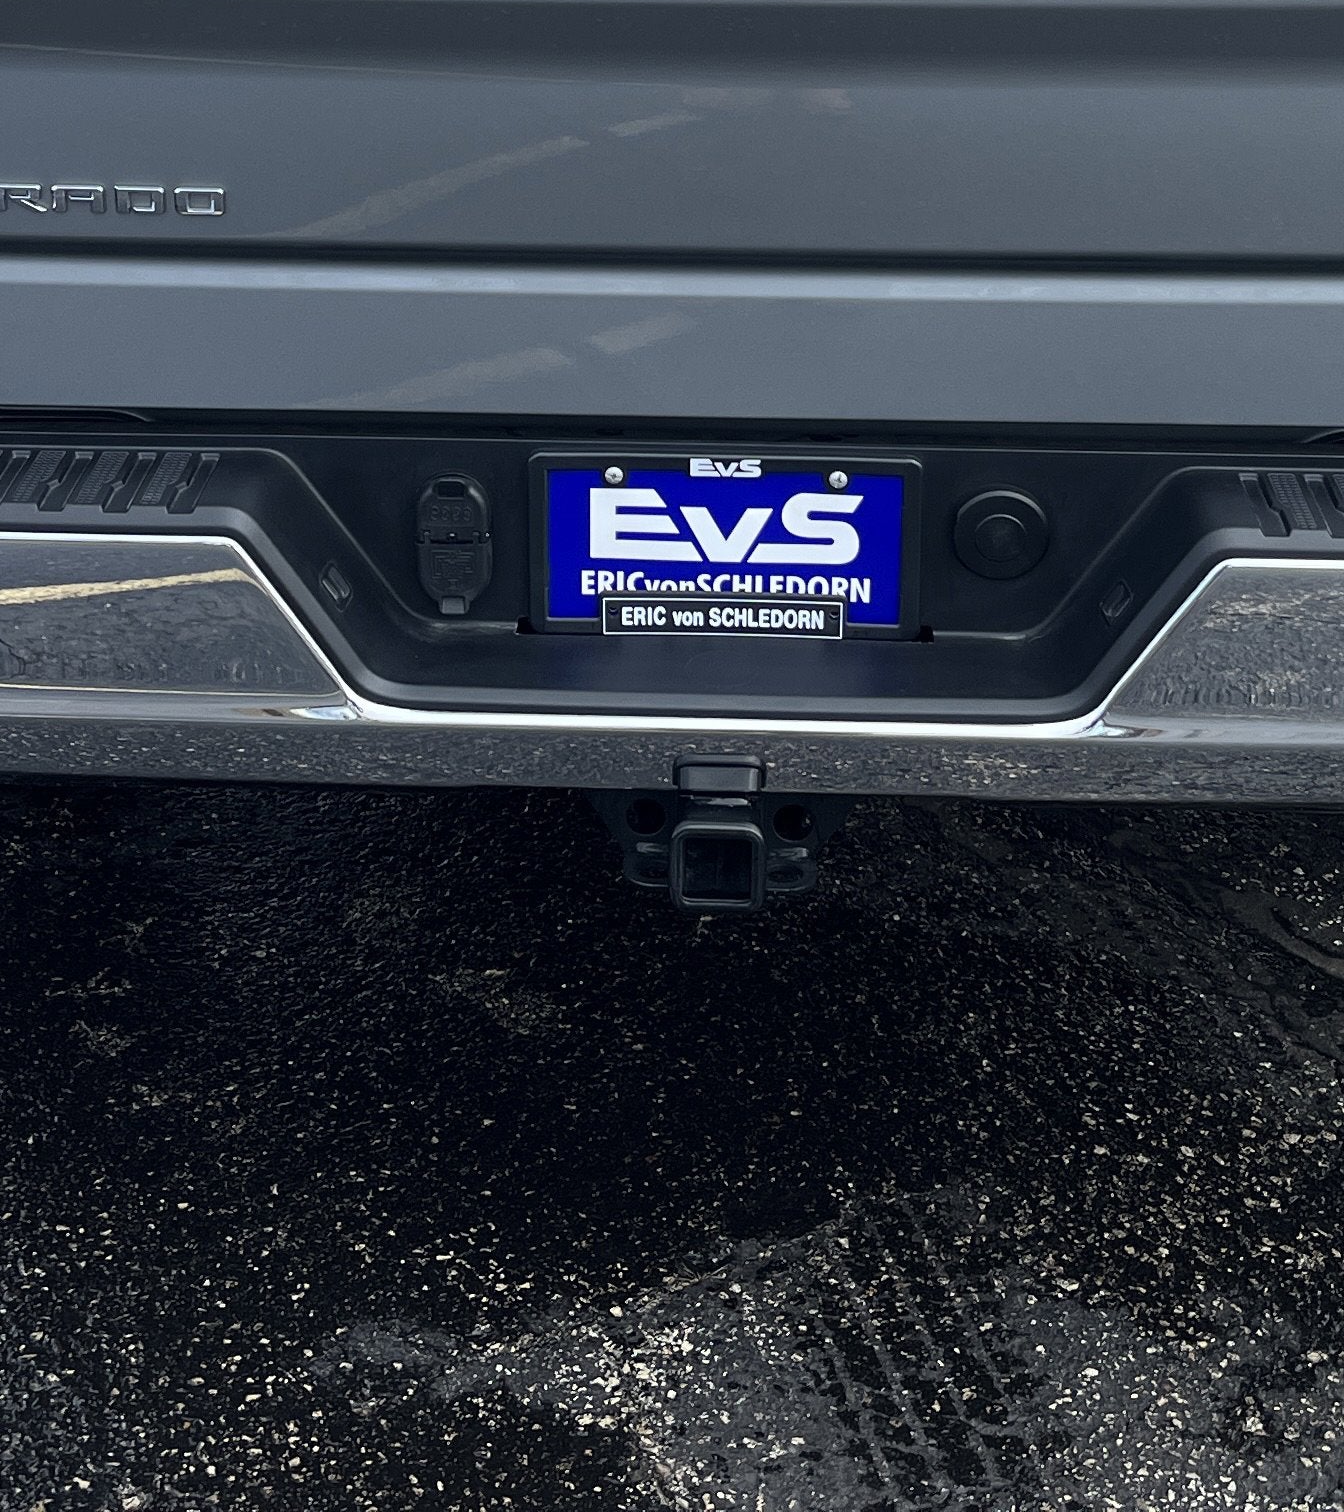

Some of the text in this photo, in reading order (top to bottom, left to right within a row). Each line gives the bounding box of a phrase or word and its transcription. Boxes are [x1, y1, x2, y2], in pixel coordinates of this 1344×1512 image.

[620, 605, 825, 630] ERIC von SCHLEDORN
